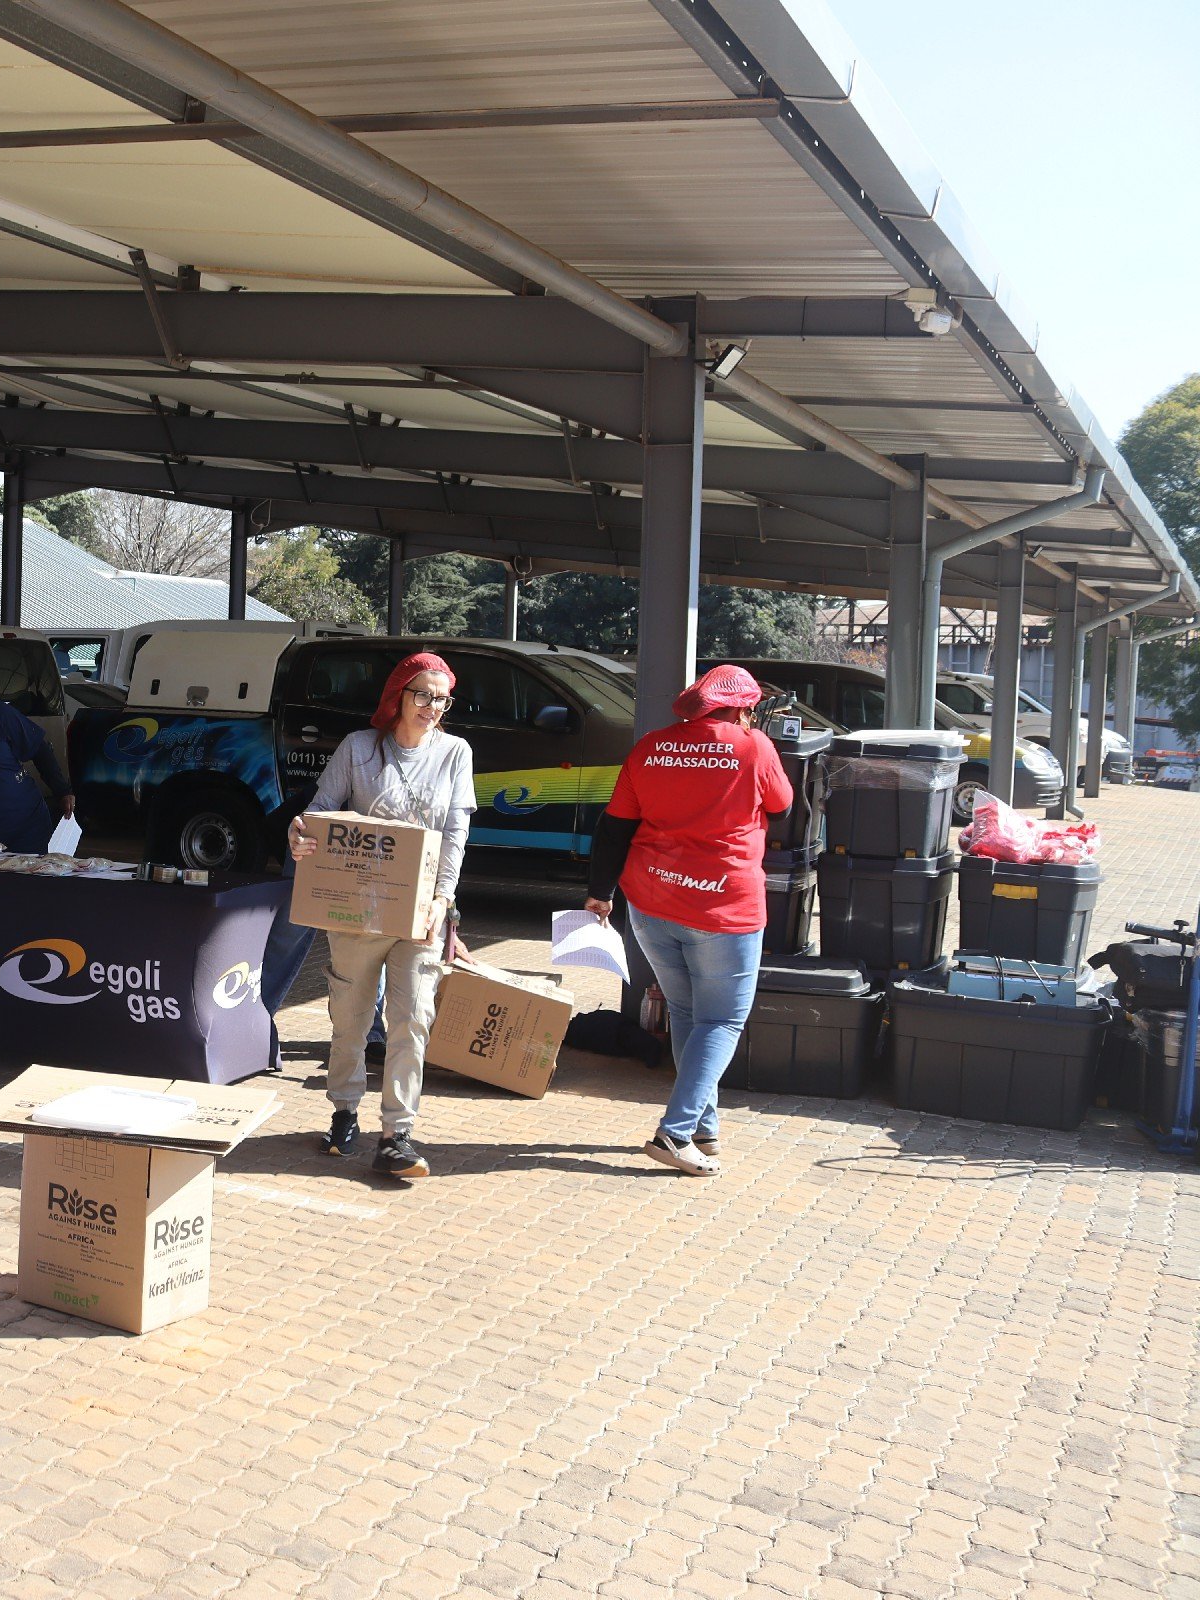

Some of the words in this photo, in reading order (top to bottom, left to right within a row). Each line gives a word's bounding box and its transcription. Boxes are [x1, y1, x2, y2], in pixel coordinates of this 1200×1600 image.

[655, 742, 734, 754] VOLUNTEER
[287, 752, 315, 767] (011)
[644, 756, 740, 770] AMBASSADOR
[327, 847, 360, 857] AGAINST
[361, 851, 395, 861] HUNGER
[655, 868, 683, 881] STARTS
[682, 874, 728, 893] meal
[89, 959, 161, 994] egoli
[127, 993, 181, 1023] gas
[48, 1212, 81, 1227] AGAINST
[83, 1221, 117, 1236] HUNGER
[67, 1232, 95, 1246] AFRICA
[153, 1246, 178, 1260] AGAINST
[180, 1237, 204, 1251] HUNGER
[167, 1257, 188, 1270] AFRICA
